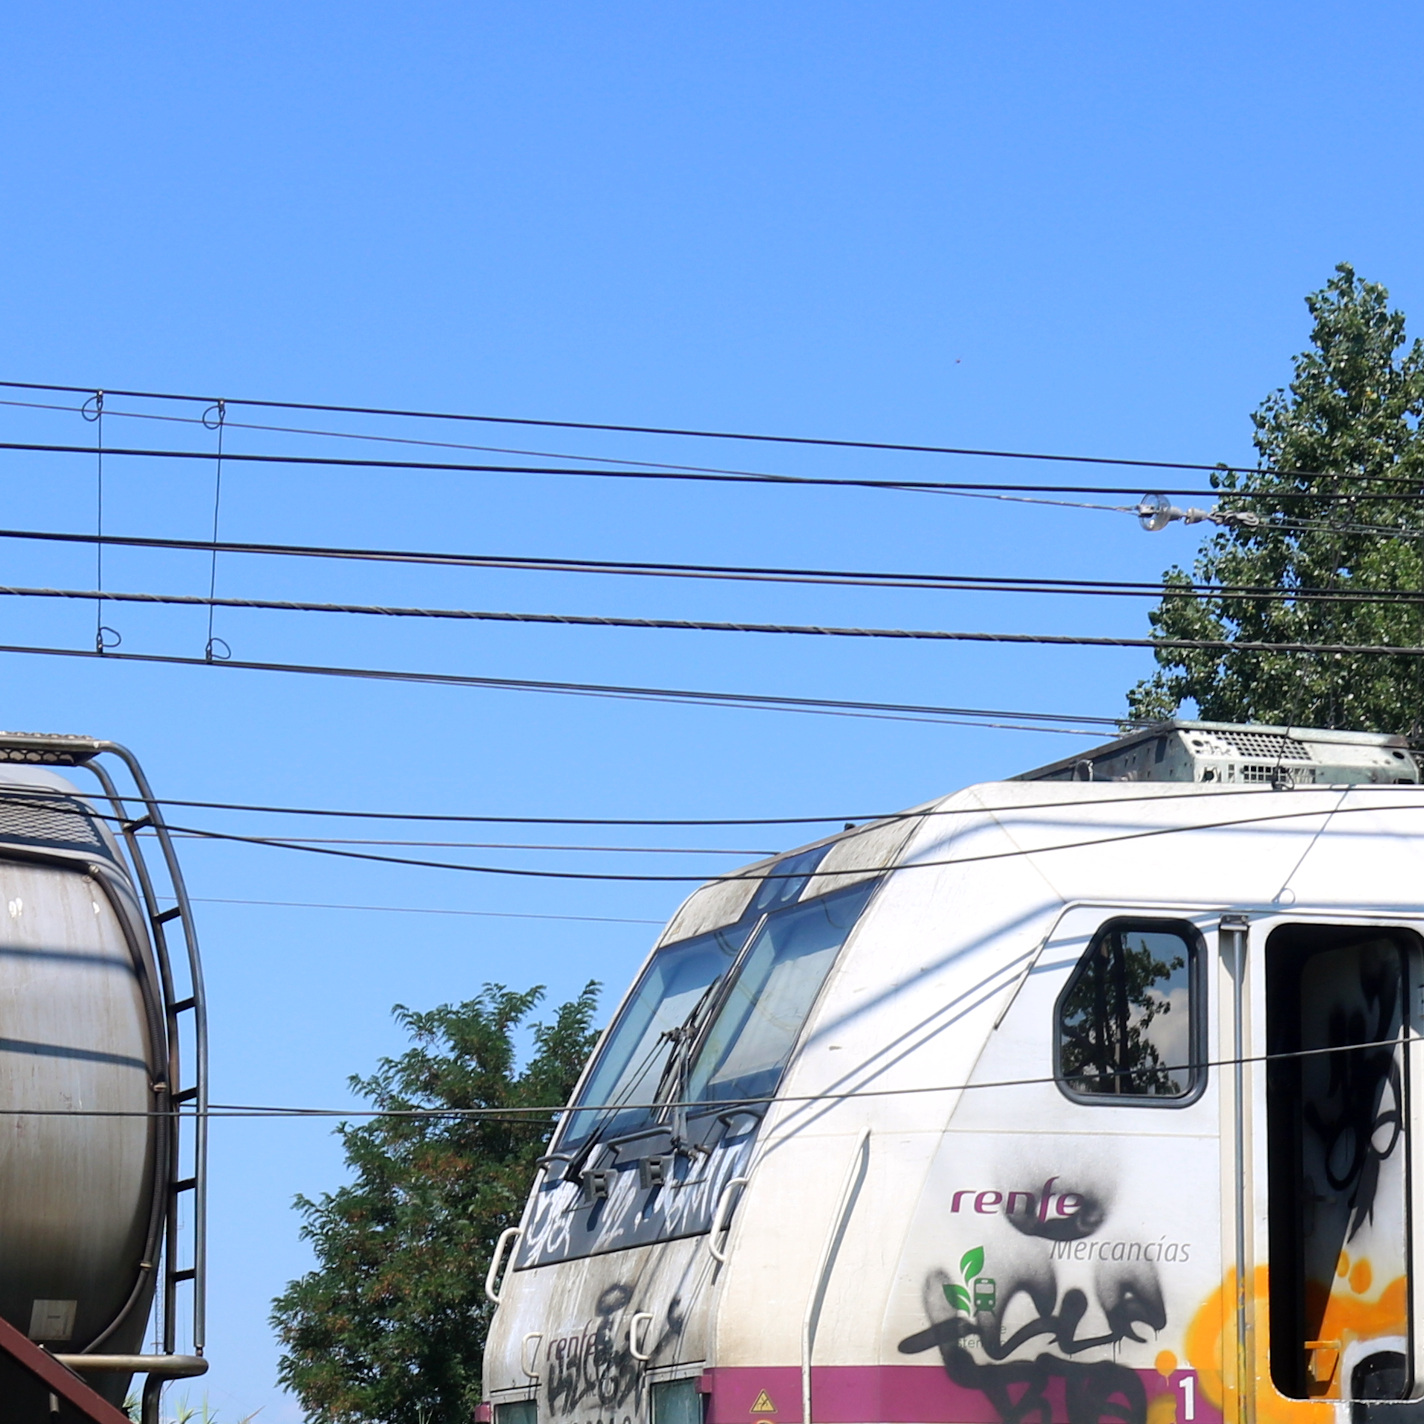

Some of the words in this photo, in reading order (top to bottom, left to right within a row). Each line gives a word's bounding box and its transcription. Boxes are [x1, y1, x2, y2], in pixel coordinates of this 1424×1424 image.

[950, 1176, 1085, 1224] renfe
[1049, 1235, 1192, 1263] Mercancías
[1178, 1376, 1196, 1421] 1
